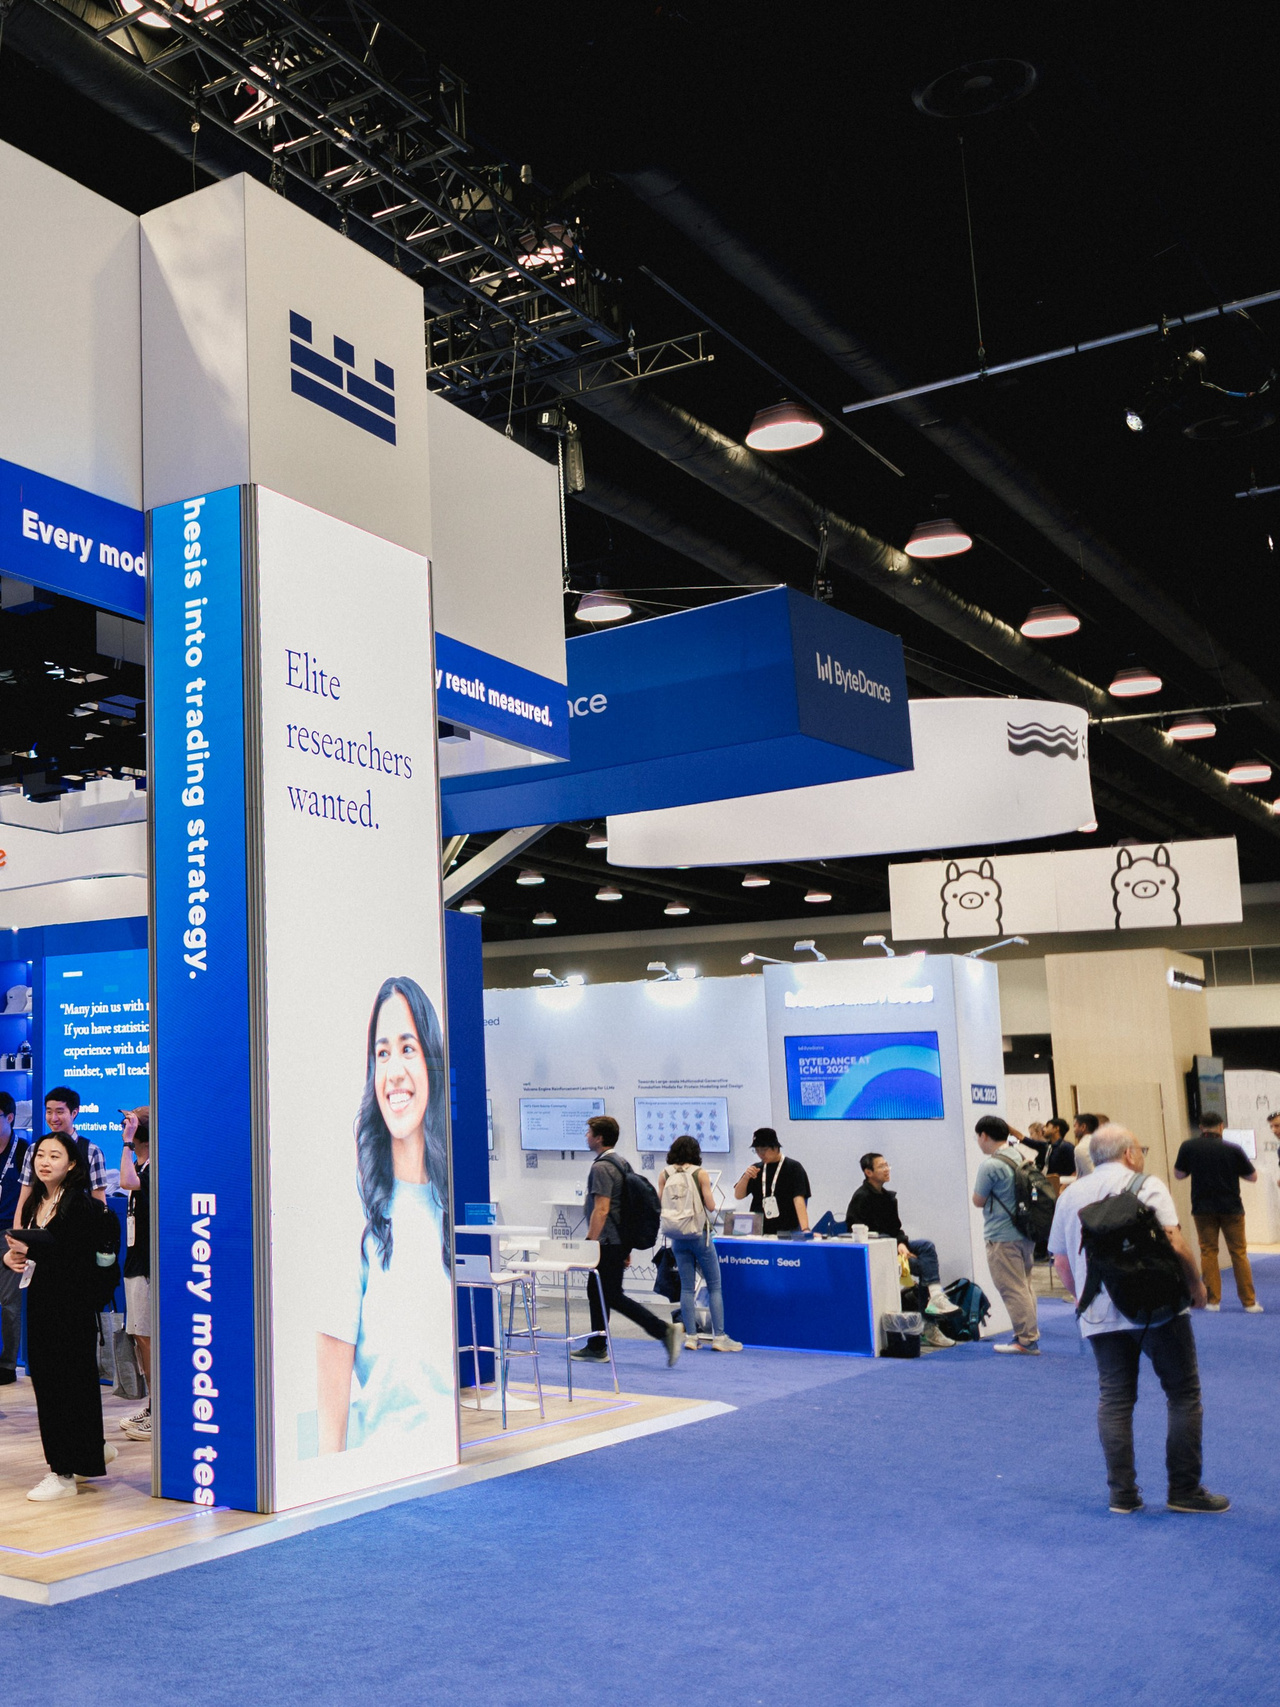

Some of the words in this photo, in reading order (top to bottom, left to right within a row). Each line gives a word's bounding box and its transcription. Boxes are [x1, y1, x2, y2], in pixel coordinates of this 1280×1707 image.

[22, 508, 94, 563] Every
[184, 597, 208, 668] into
[285, 649, 341, 701] Elite
[834, 661, 891, 703] ByteDance
[445, 672, 486, 703] result
[487, 688, 553, 728] measured.
[181, 677, 211, 807] trading
[286, 723, 413, 779] researchers
[287, 785, 379, 830] wanted.
[183, 818, 210, 980] strategy.
[64, 1023, 74, 1036] If
[73, 1026, 90, 1039] you
[91, 1022, 111, 1035] have
[90, 1002, 109, 1017] join
[110, 1003, 121, 1012] us
[123, 999, 144, 1012] with
[64, 1043, 111, 1060] experience
[113, 1041, 135, 1054] with
[64, 1064, 104, 1079] mindset,
[799, 1056, 857, 1066] BYTEDANCE
[858, 1056, 871, 1065] AT
[800, 1066, 825, 1075] ICML
[826, 1065, 850, 1074] 2025
[186, 1193, 217, 1303] Every
[730, 1256, 770, 1266] ByteDance
[777, 1258, 800, 1267] Seed
[192, 1313, 220, 1434] model
